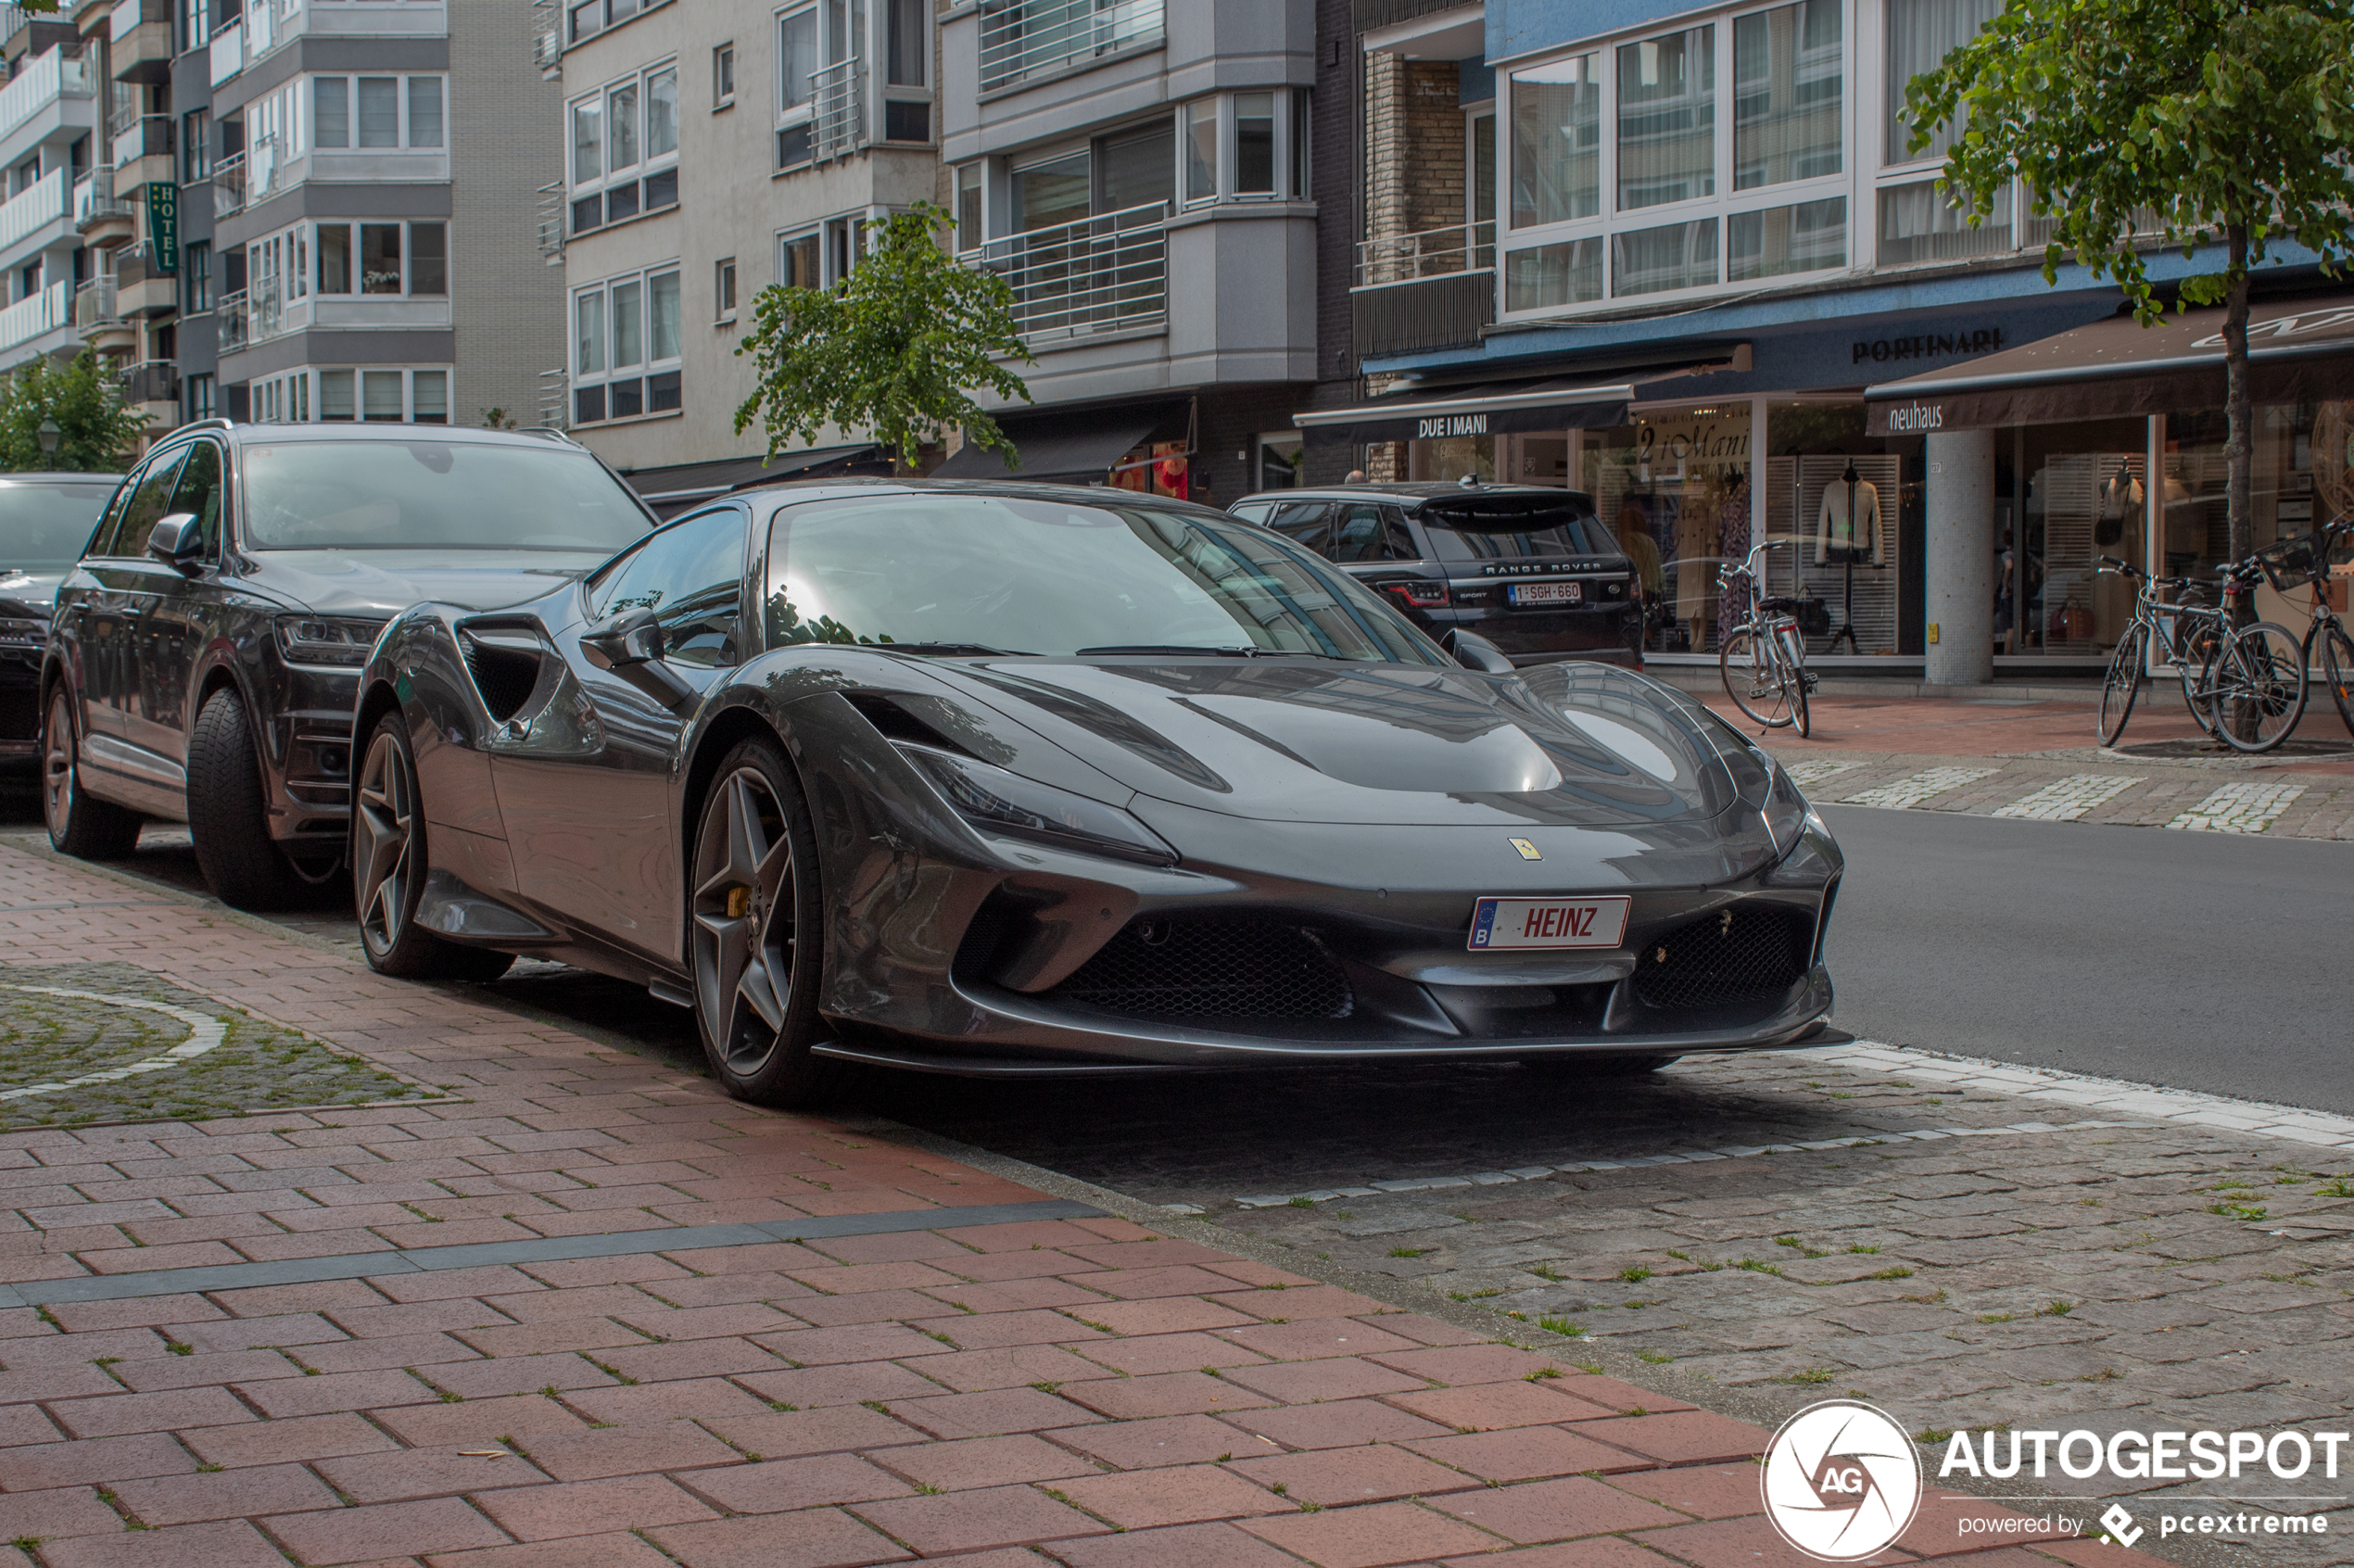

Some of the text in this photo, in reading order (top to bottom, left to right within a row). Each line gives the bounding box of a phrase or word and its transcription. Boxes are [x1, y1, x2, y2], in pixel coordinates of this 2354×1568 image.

[161, 186, 174, 267] HOTEL
[1852, 328, 2004, 364] PORTINARI
[1419, 413, 1487, 439] DUE I MANI
[1890, 399, 1943, 431] neuhaus
[1640, 427, 1655, 463] 2
[1486, 563, 1601, 575] RANGE ROVER
[1474, 929, 1487, 944] B
[1524, 907, 1598, 938] HEINZ
